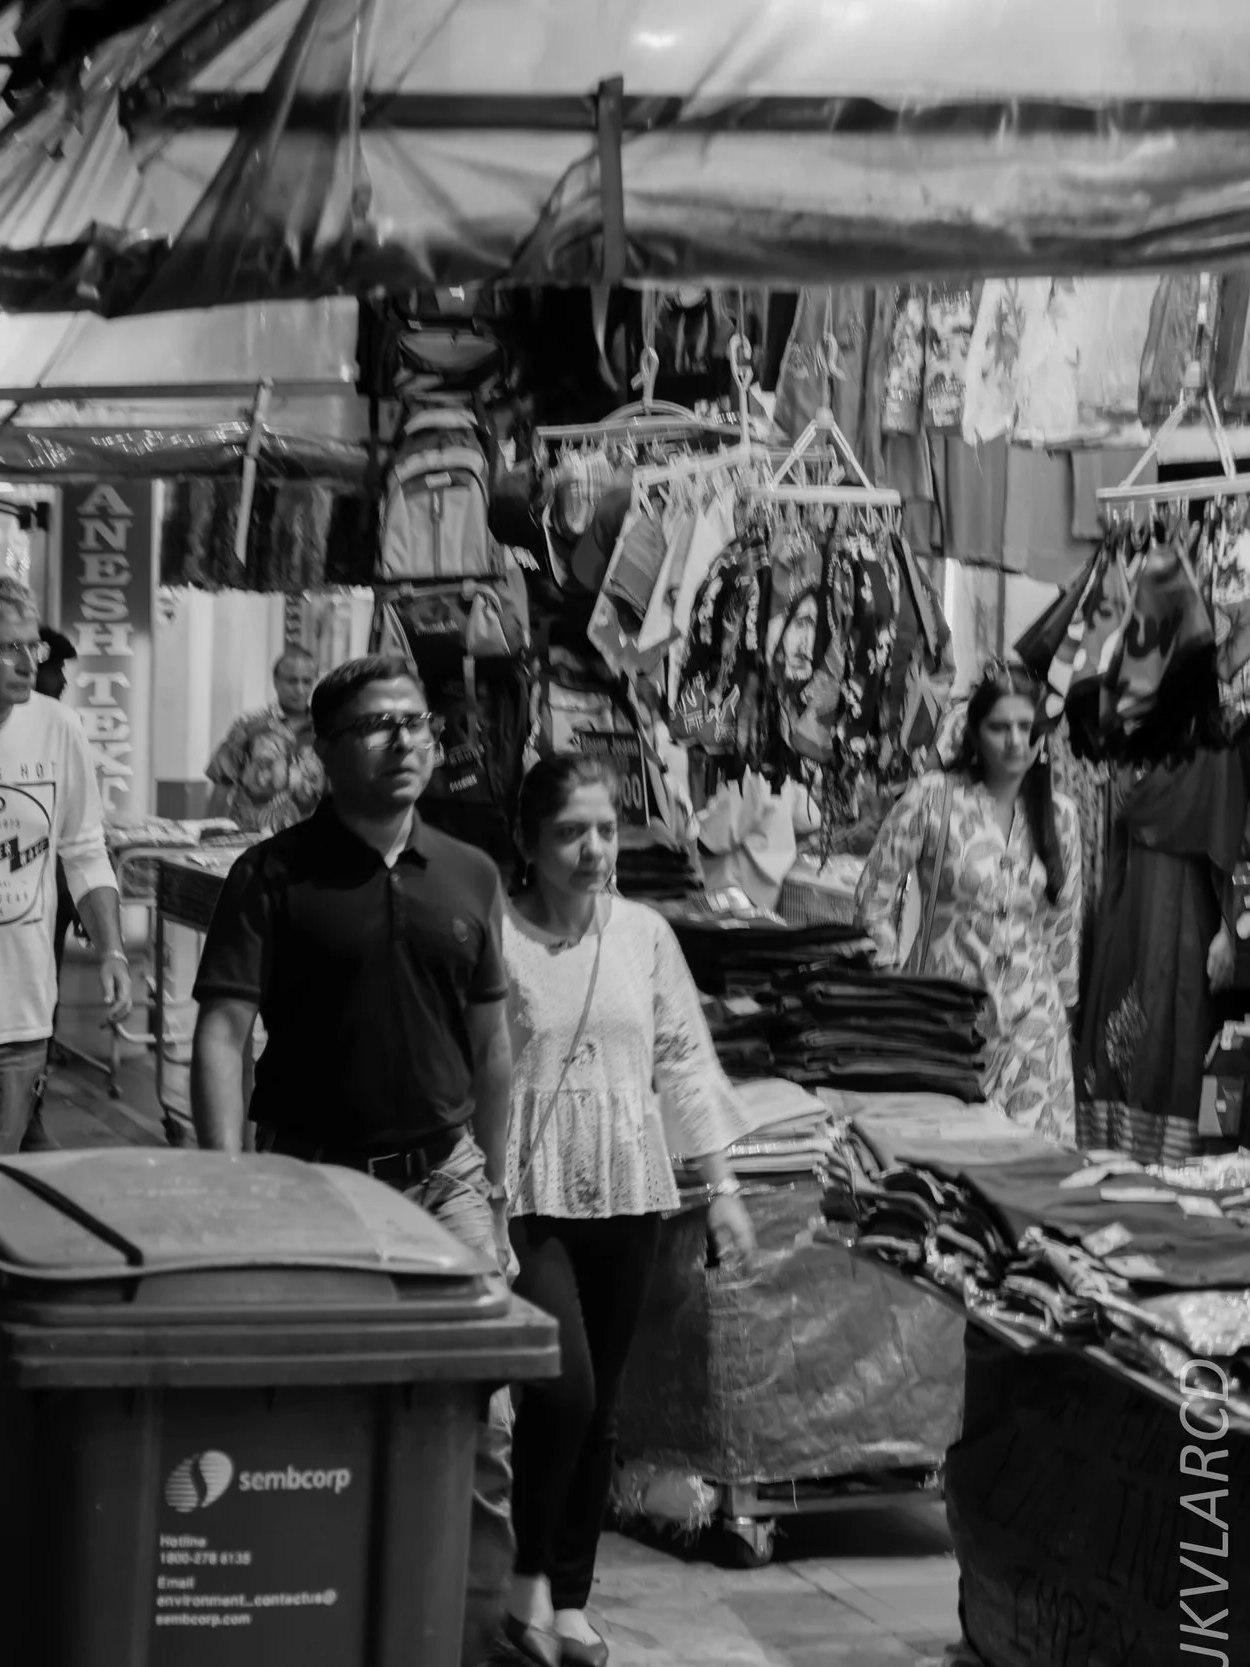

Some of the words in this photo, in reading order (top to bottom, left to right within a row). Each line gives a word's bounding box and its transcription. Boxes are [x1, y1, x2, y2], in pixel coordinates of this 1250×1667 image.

[20, 760, 57, 780] HOT
[238, 1464, 352, 1495] sembcorp
[159, 1533, 208, 1548] Hotline
[157, 1575, 196, 1590] Email
[155, 1612, 253, 1628] sembcorp.com
